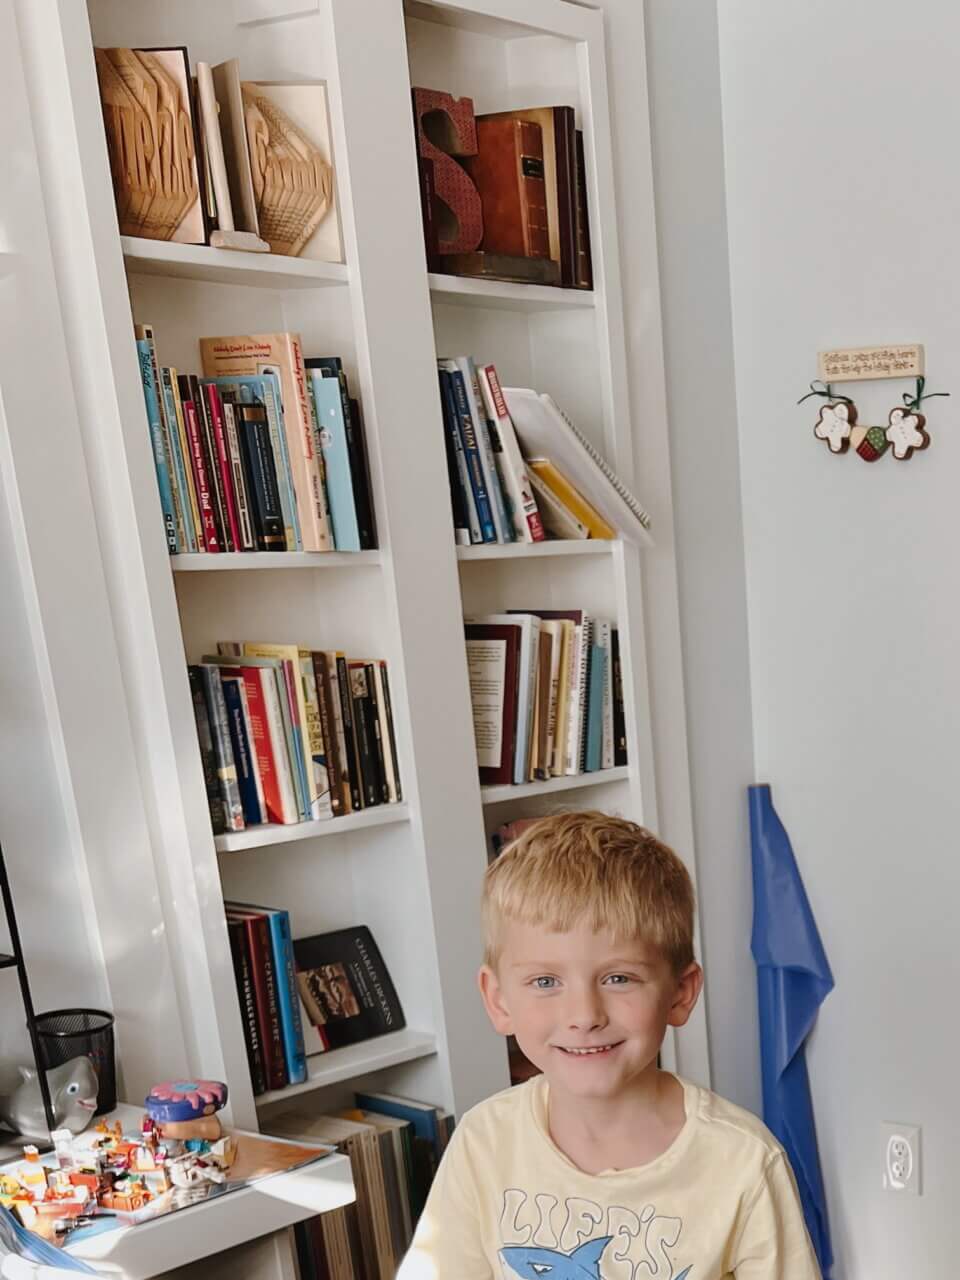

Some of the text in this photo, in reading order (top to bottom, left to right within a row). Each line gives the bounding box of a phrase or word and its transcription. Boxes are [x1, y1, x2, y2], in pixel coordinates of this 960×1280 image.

[201, 492, 210, 510] Dad
[244, 981, 255, 1019] HUNGER
[250, 1020, 259, 1049] GAMES
[264, 962, 280, 1041] CATCHING FIRE
[355, 937, 378, 982] CHARLES
[373, 981, 393, 1025] DICKENS
